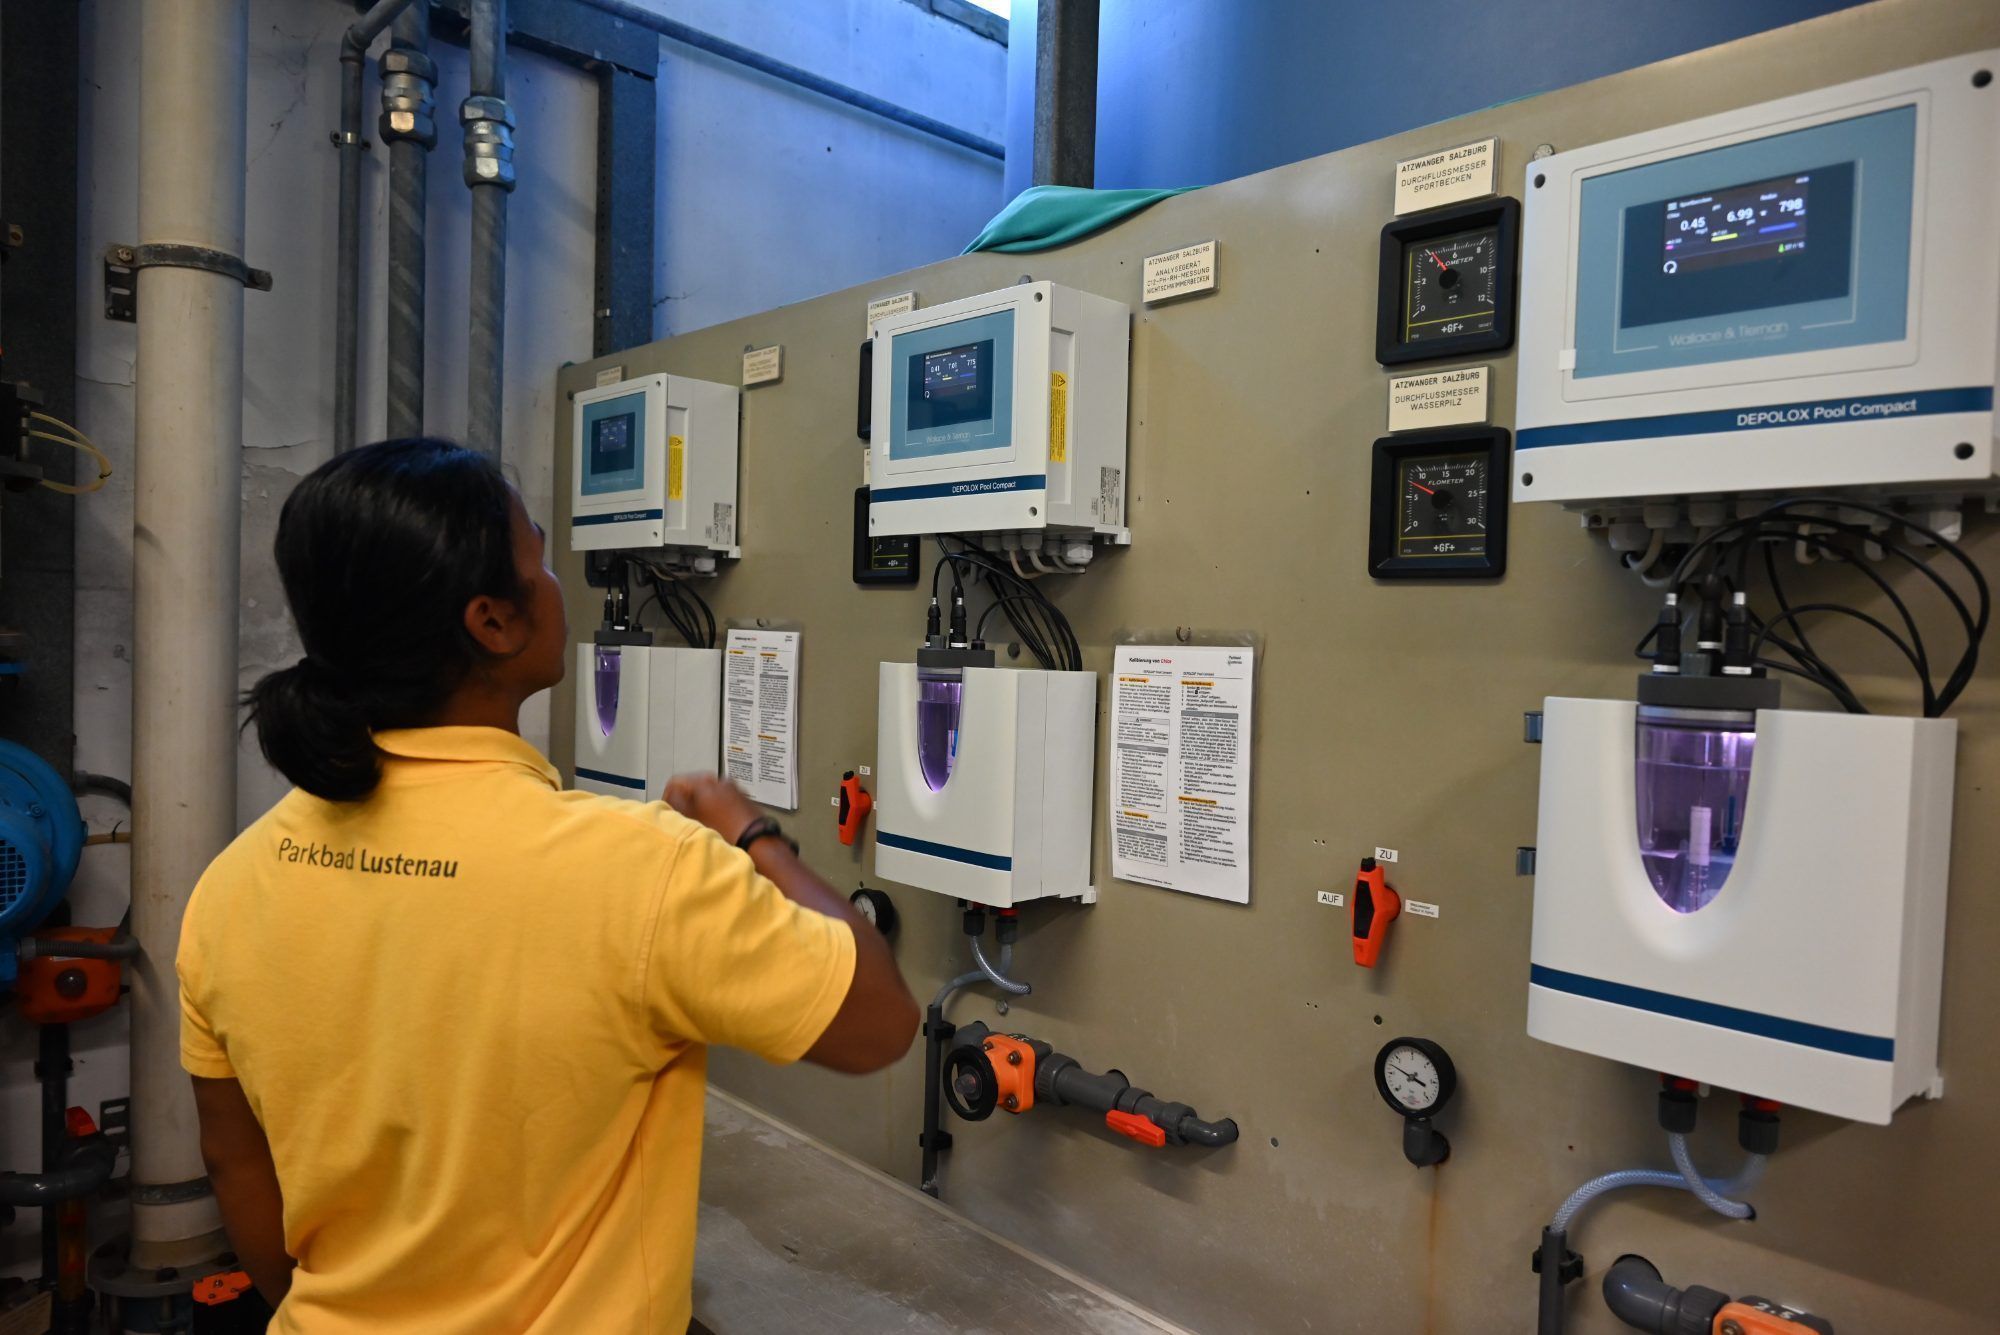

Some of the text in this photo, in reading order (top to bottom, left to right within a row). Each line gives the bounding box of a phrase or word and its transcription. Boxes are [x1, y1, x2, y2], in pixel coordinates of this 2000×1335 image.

[1402, 145, 1487, 172] ATZWANGER SALZBURG
[1401, 160, 1486, 187] DURCHFLUSSMESSER
[1414, 173, 1472, 193] SPORTBECKEN
[1779, 198, 1802, 212] 798
[1726, 208, 1753, 222] 6.99
[1680, 216, 1706, 231] 0.45
[1182, 246, 1210, 258] SALZBURG
[1437, 256, 1474, 268] OMETER
[1668, 332, 1721, 346] Wallace
[1725, 327, 1735, 338] &
[1395, 372, 1480, 388] ATZWANGER SALZBURG
[1395, 387, 1480, 403] DURCHFLUSSMESSER
[1410, 398, 1462, 410] WASSERPILZ
[1737, 399, 1916, 426] DEPOLOX Pool Compact
[952, 484, 978, 493] DEPOLOX
[992, 481, 1016, 490] Compact
[278, 838, 458, 878] Parkbad Lustenau
[1380, 850, 1392, 860] ZU
[1322, 894, 1340, 904] AUF
